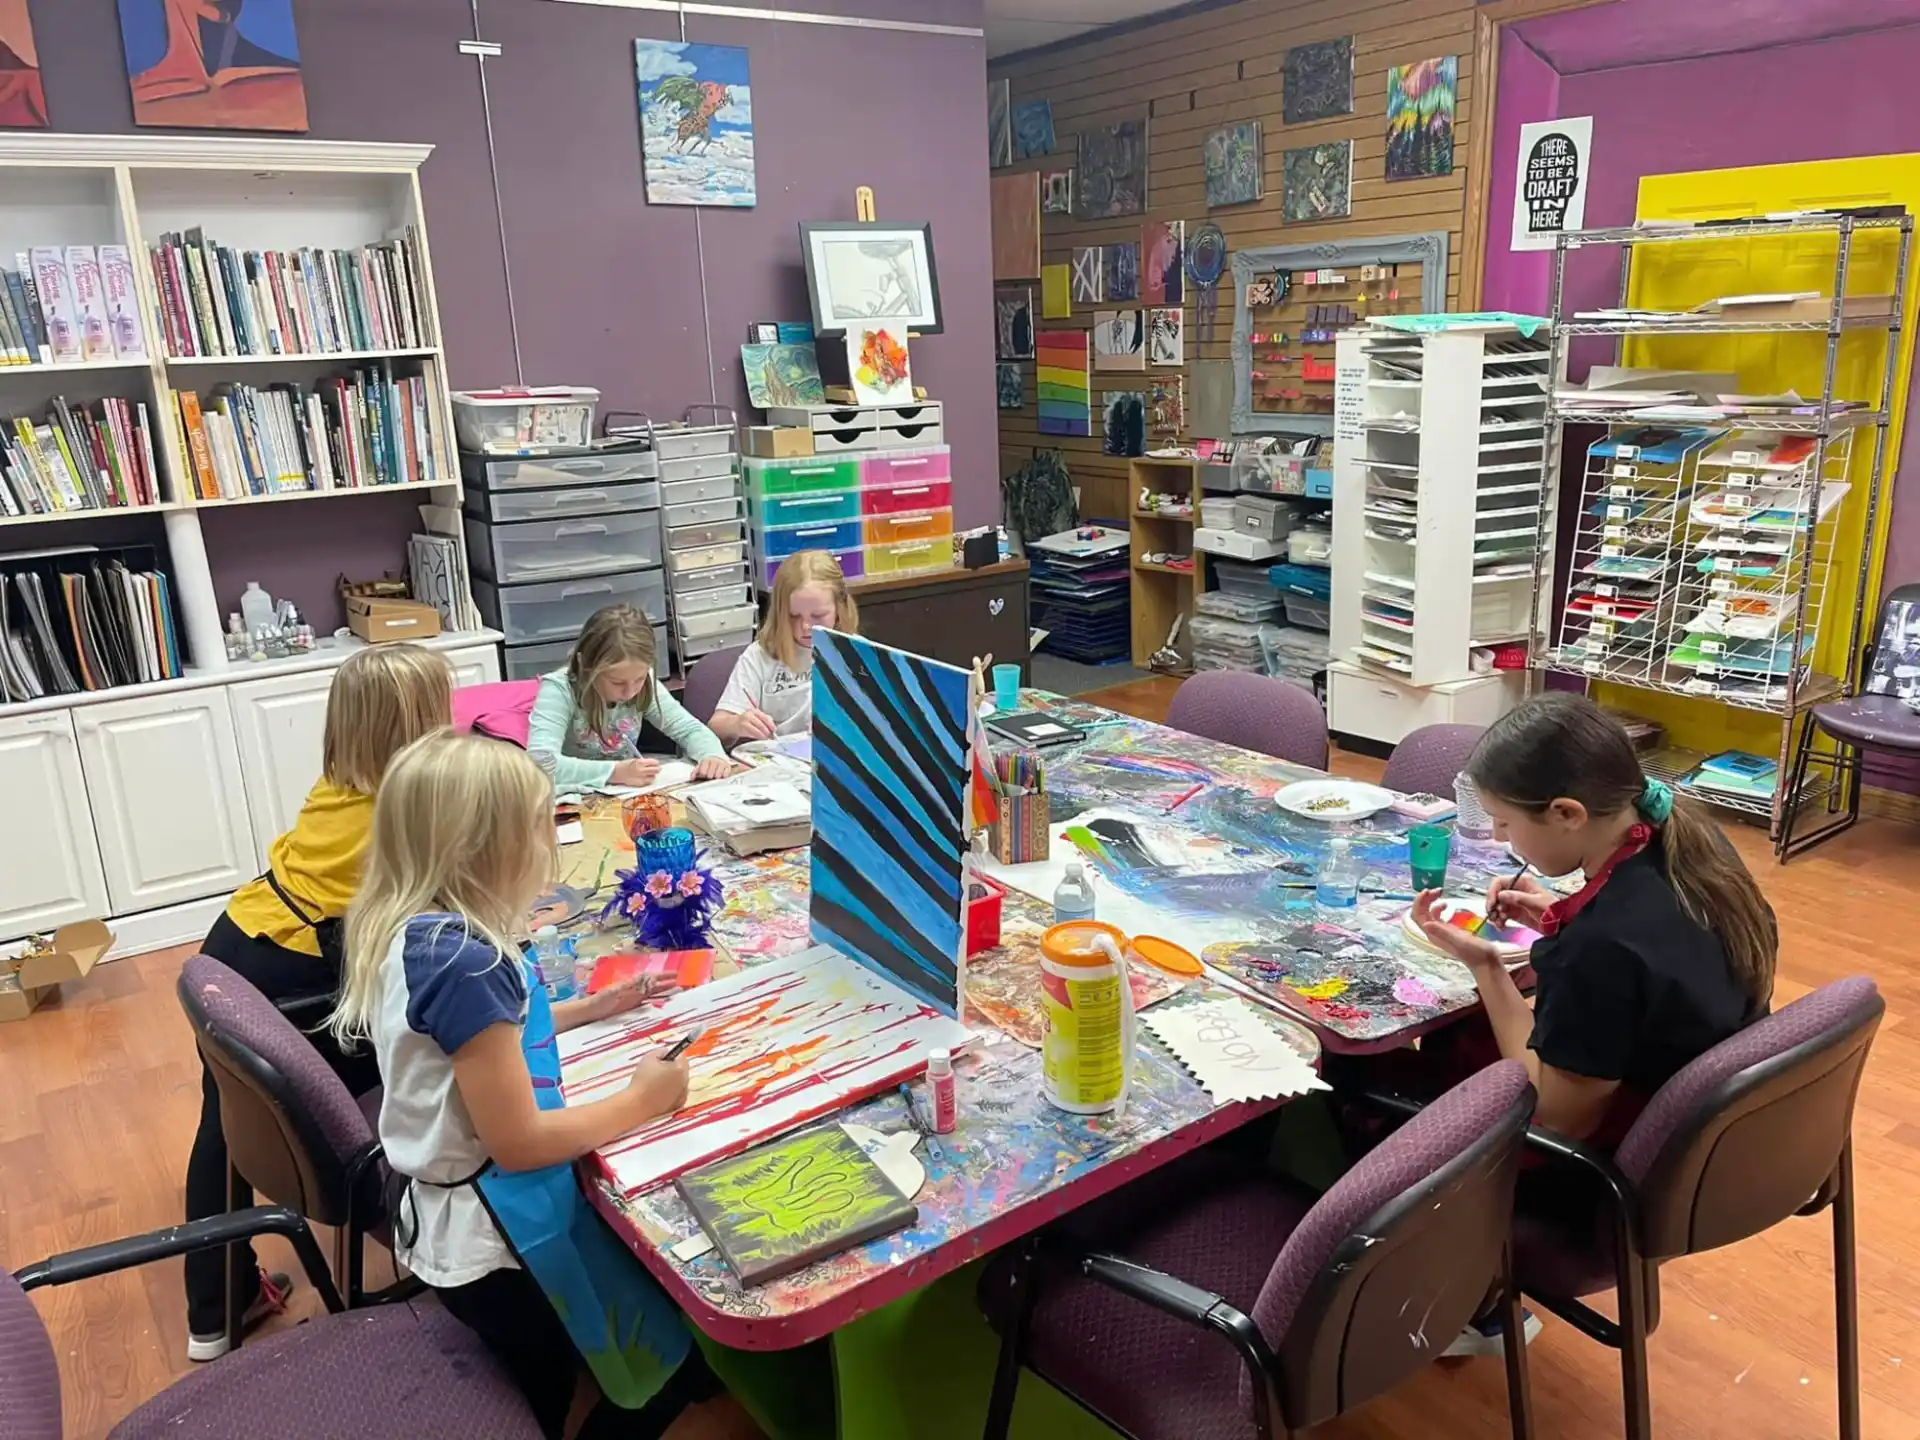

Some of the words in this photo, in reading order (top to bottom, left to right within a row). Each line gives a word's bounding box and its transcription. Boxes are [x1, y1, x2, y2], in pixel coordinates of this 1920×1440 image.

[1540, 138, 1568, 157] THERE
[1531, 155, 1576, 169] SEEMS
[1528, 169, 1544, 180] TO
[1547, 167, 1563, 178] BE
[1566, 166, 1575, 177] A
[1527, 178, 1574, 199] DRAFT
[1532, 198, 1566, 210] IN
[1531, 210, 1562, 228] HERE.
[191, 428, 205, 452] Gogh
[199, 454, 209, 470] Van
